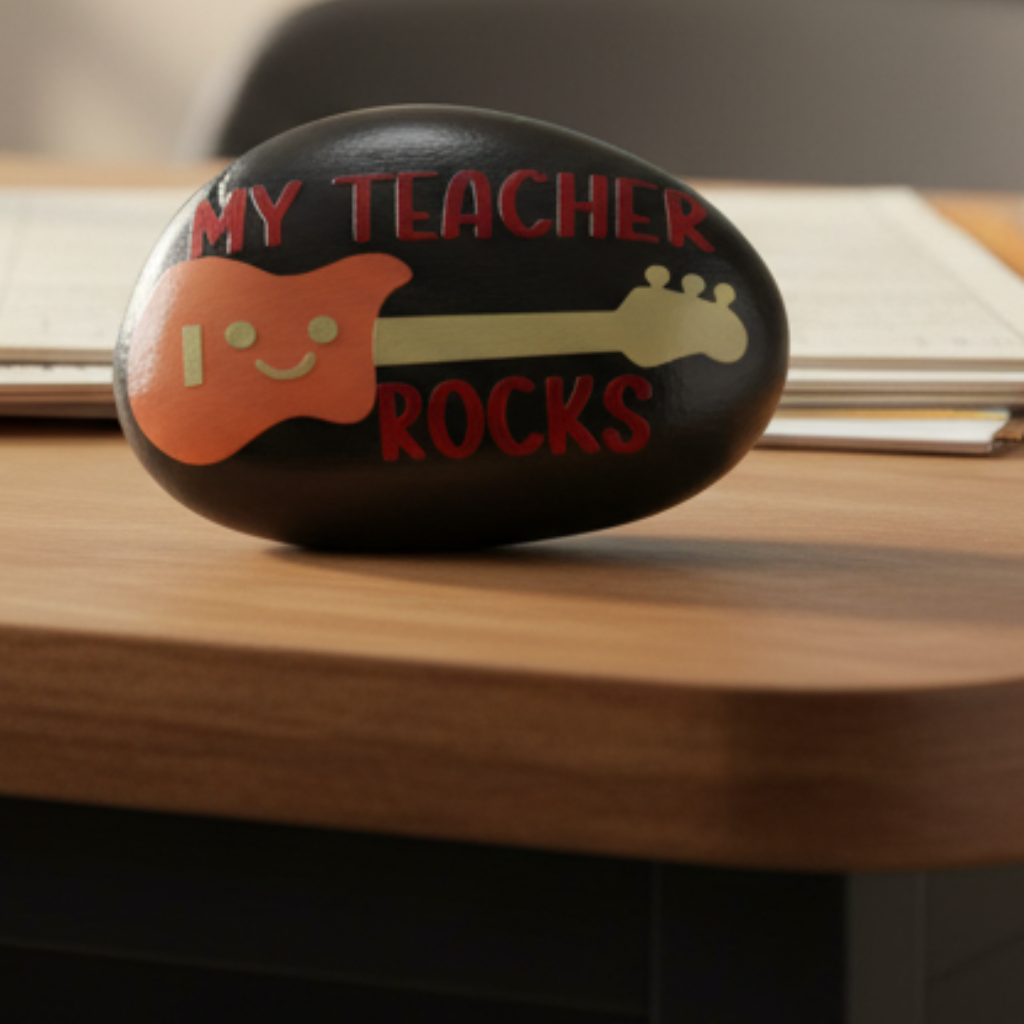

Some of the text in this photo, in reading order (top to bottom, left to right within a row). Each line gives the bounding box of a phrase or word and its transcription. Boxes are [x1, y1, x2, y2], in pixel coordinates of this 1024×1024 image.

[191, 169, 715, 259] MY TEACHER
[377, 375, 654, 462] ROCKS
